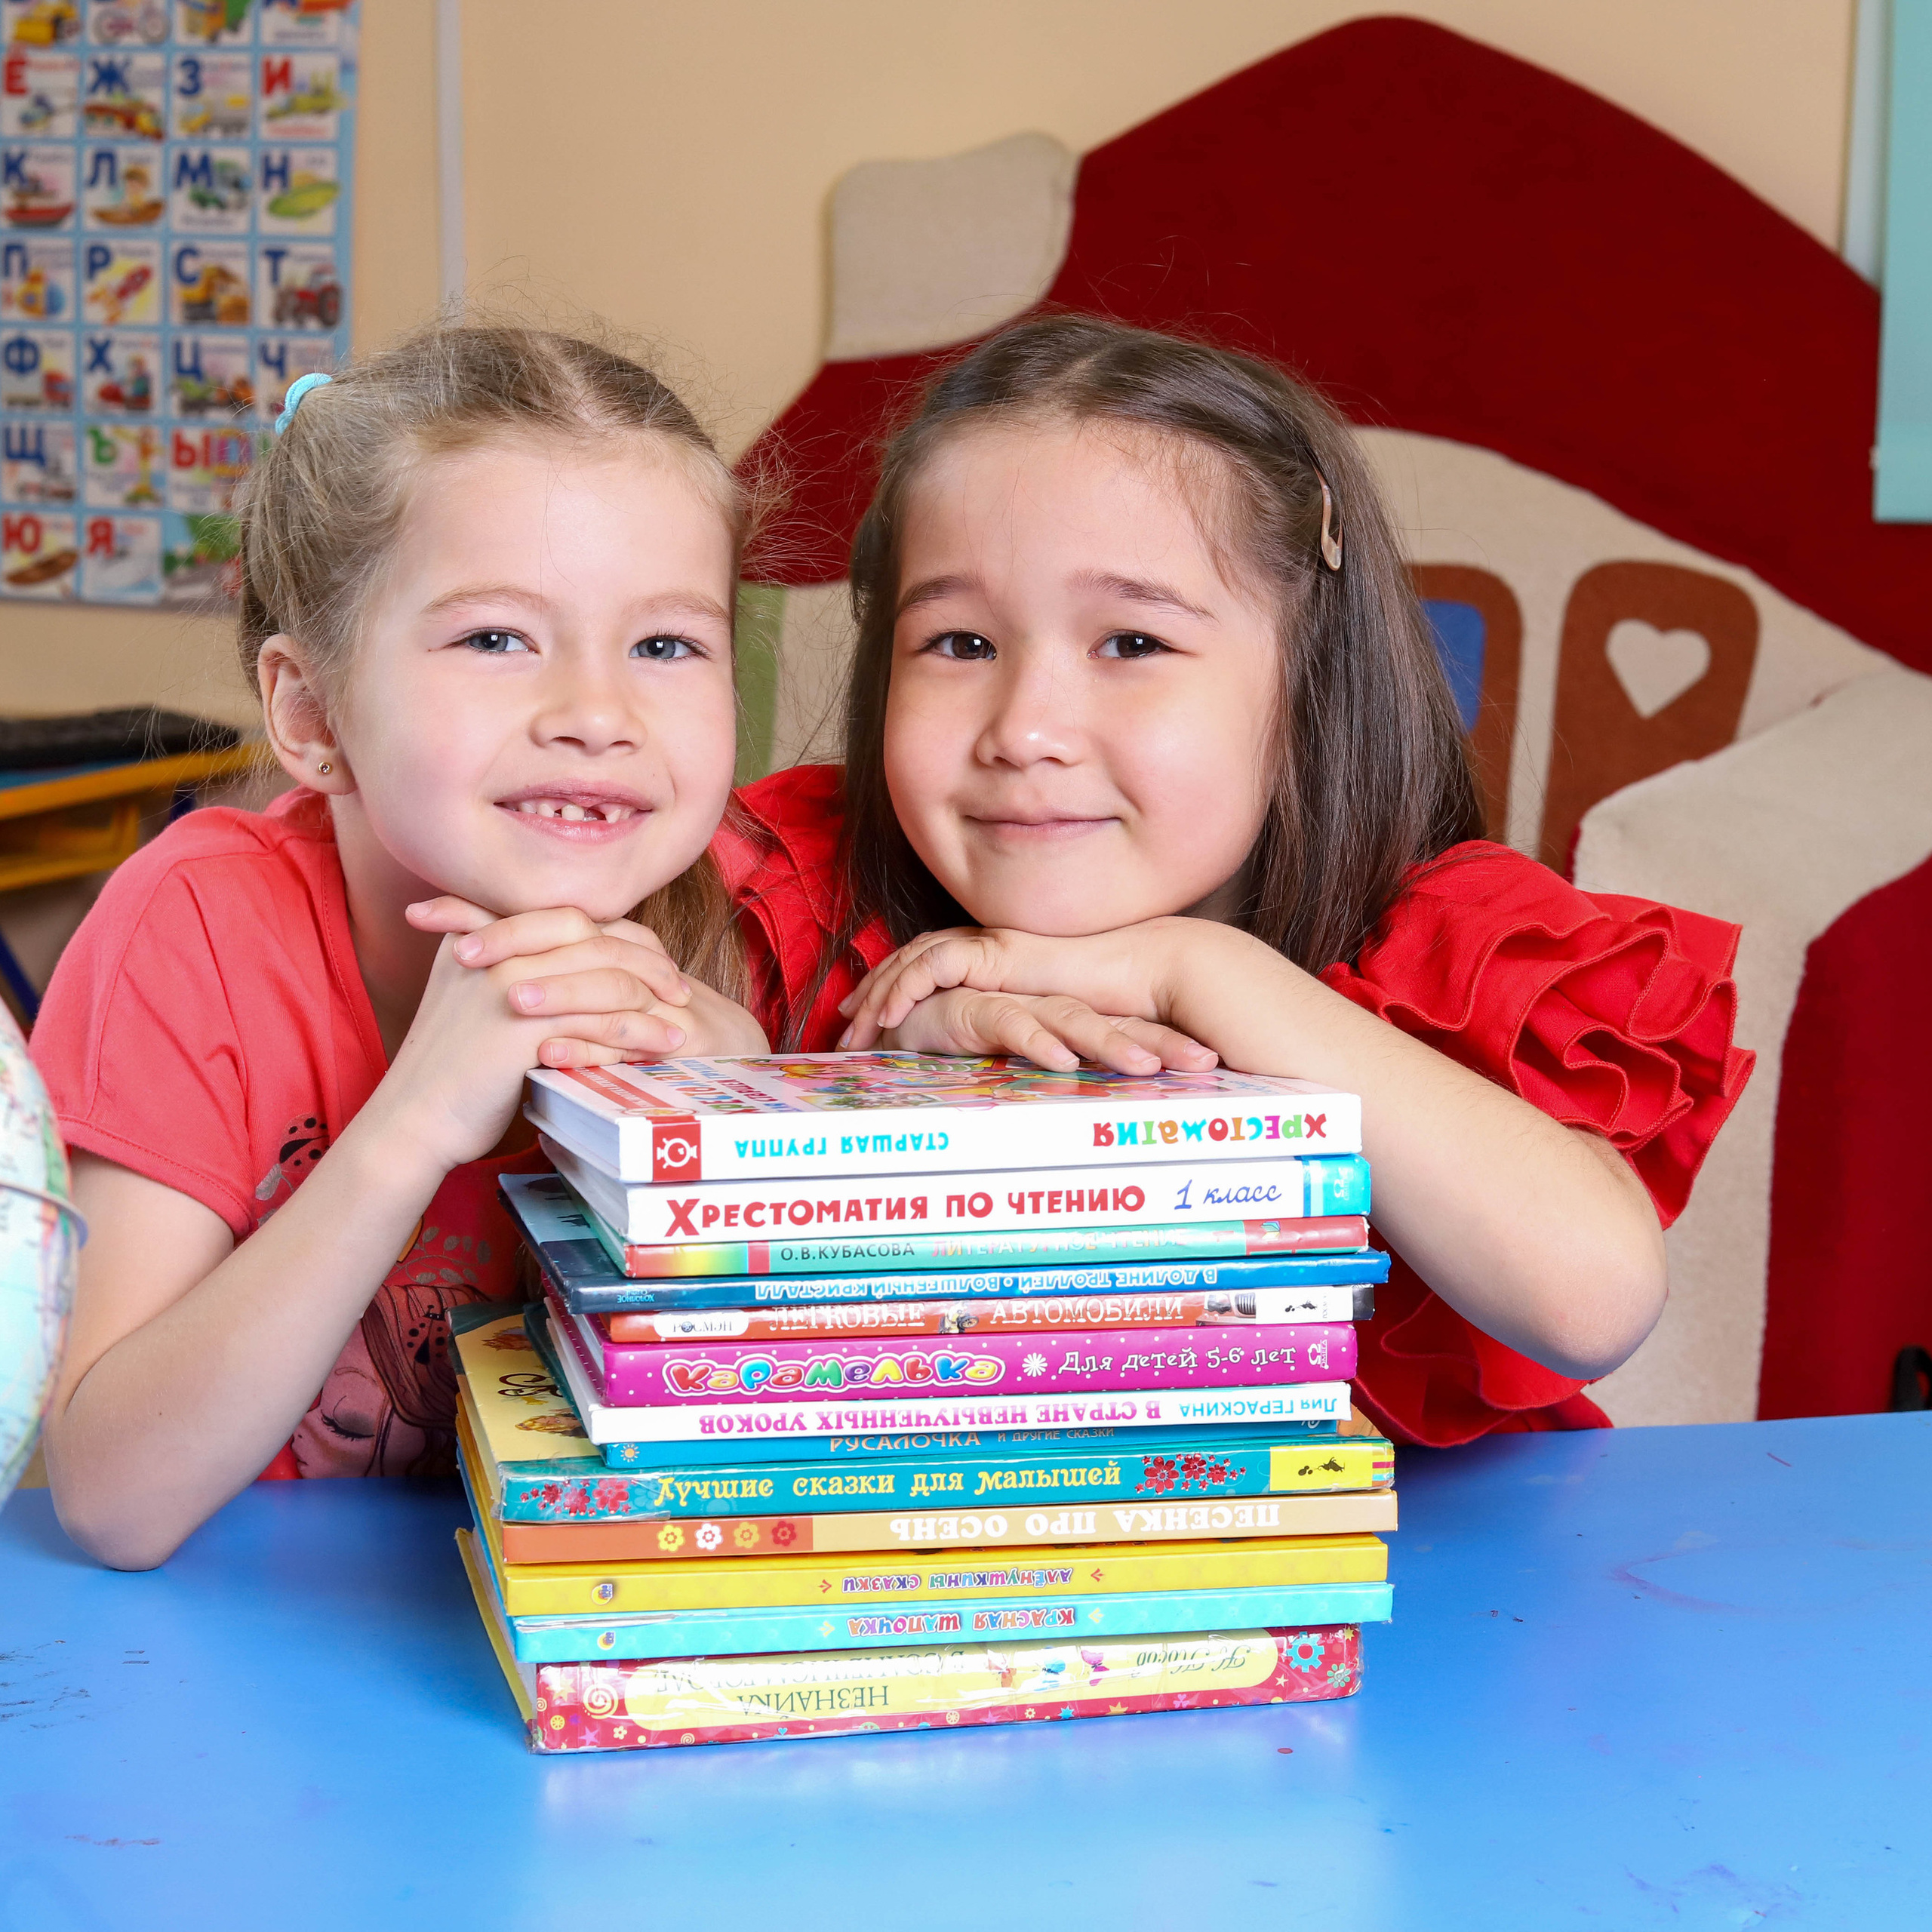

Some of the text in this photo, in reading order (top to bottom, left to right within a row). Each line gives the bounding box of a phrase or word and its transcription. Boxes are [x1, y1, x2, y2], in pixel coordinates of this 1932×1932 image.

[88, 58, 131, 95] Ж
[261, 54, 293, 97] И
[4, 151, 28, 186] К
[87, 151, 117, 187] Л
[176, 153, 213, 189] М
[262, 154, 289, 189] Н
[4, 243, 28, 278] П
[88, 244, 112, 282] Р
[174, 247, 201, 285] С
[263, 248, 288, 285] Т
[4, 336, 40, 375] Ф
[88, 337, 112, 373] Х
[174, 340, 203, 381] Ц
[260, 341, 286, 379] Ч
[4, 425, 47, 468] Щ
[87, 425, 117, 466] Ъ
[171, 427, 211, 470] Ы
[2, 515, 41, 554] Ю
[87, 517, 114, 557] Я
[734, 1132, 949, 1158] СТАРШАЯ ГРУППА
[946, 1192, 994, 1218] ПО
[1008, 1186, 1146, 1216] ЧТЕНИЮ
[1174, 1179, 1282, 1210] 1 класс
[755, 1267, 1217, 1300] В ДОЛИНЕ ТРОЛЛЕЙ ВОЛШЕБНЫЙ КРИСТАЛЛ
[990, 1296, 1185, 1324] АВТОМОБИЛИ
[1057, 1345, 1297, 1376] Для детей 5-6 лет
[699, 1401, 1161, 1435] В СТРАНЕ НЕВЫУЧЕННЫХ УРОКОВ
[1180, 1398, 1337, 1417] Лия ГЕРАСКИНА
[830, 1432, 981, 1453] РУСАЛОЧКА
[654, 1461, 1121, 1506] Лучшие сказки для малышей
[890, 1503, 1281, 1541] ПЕСЕНКА ПРО ОСЕНЬ
[842, 1574, 921, 1593] СКАЗКИ
[848, 1607, 1075, 1637] КРАСНАЯ ШАПОЧКА
[737, 1685, 890, 1720] НЕЗНАЙКА
